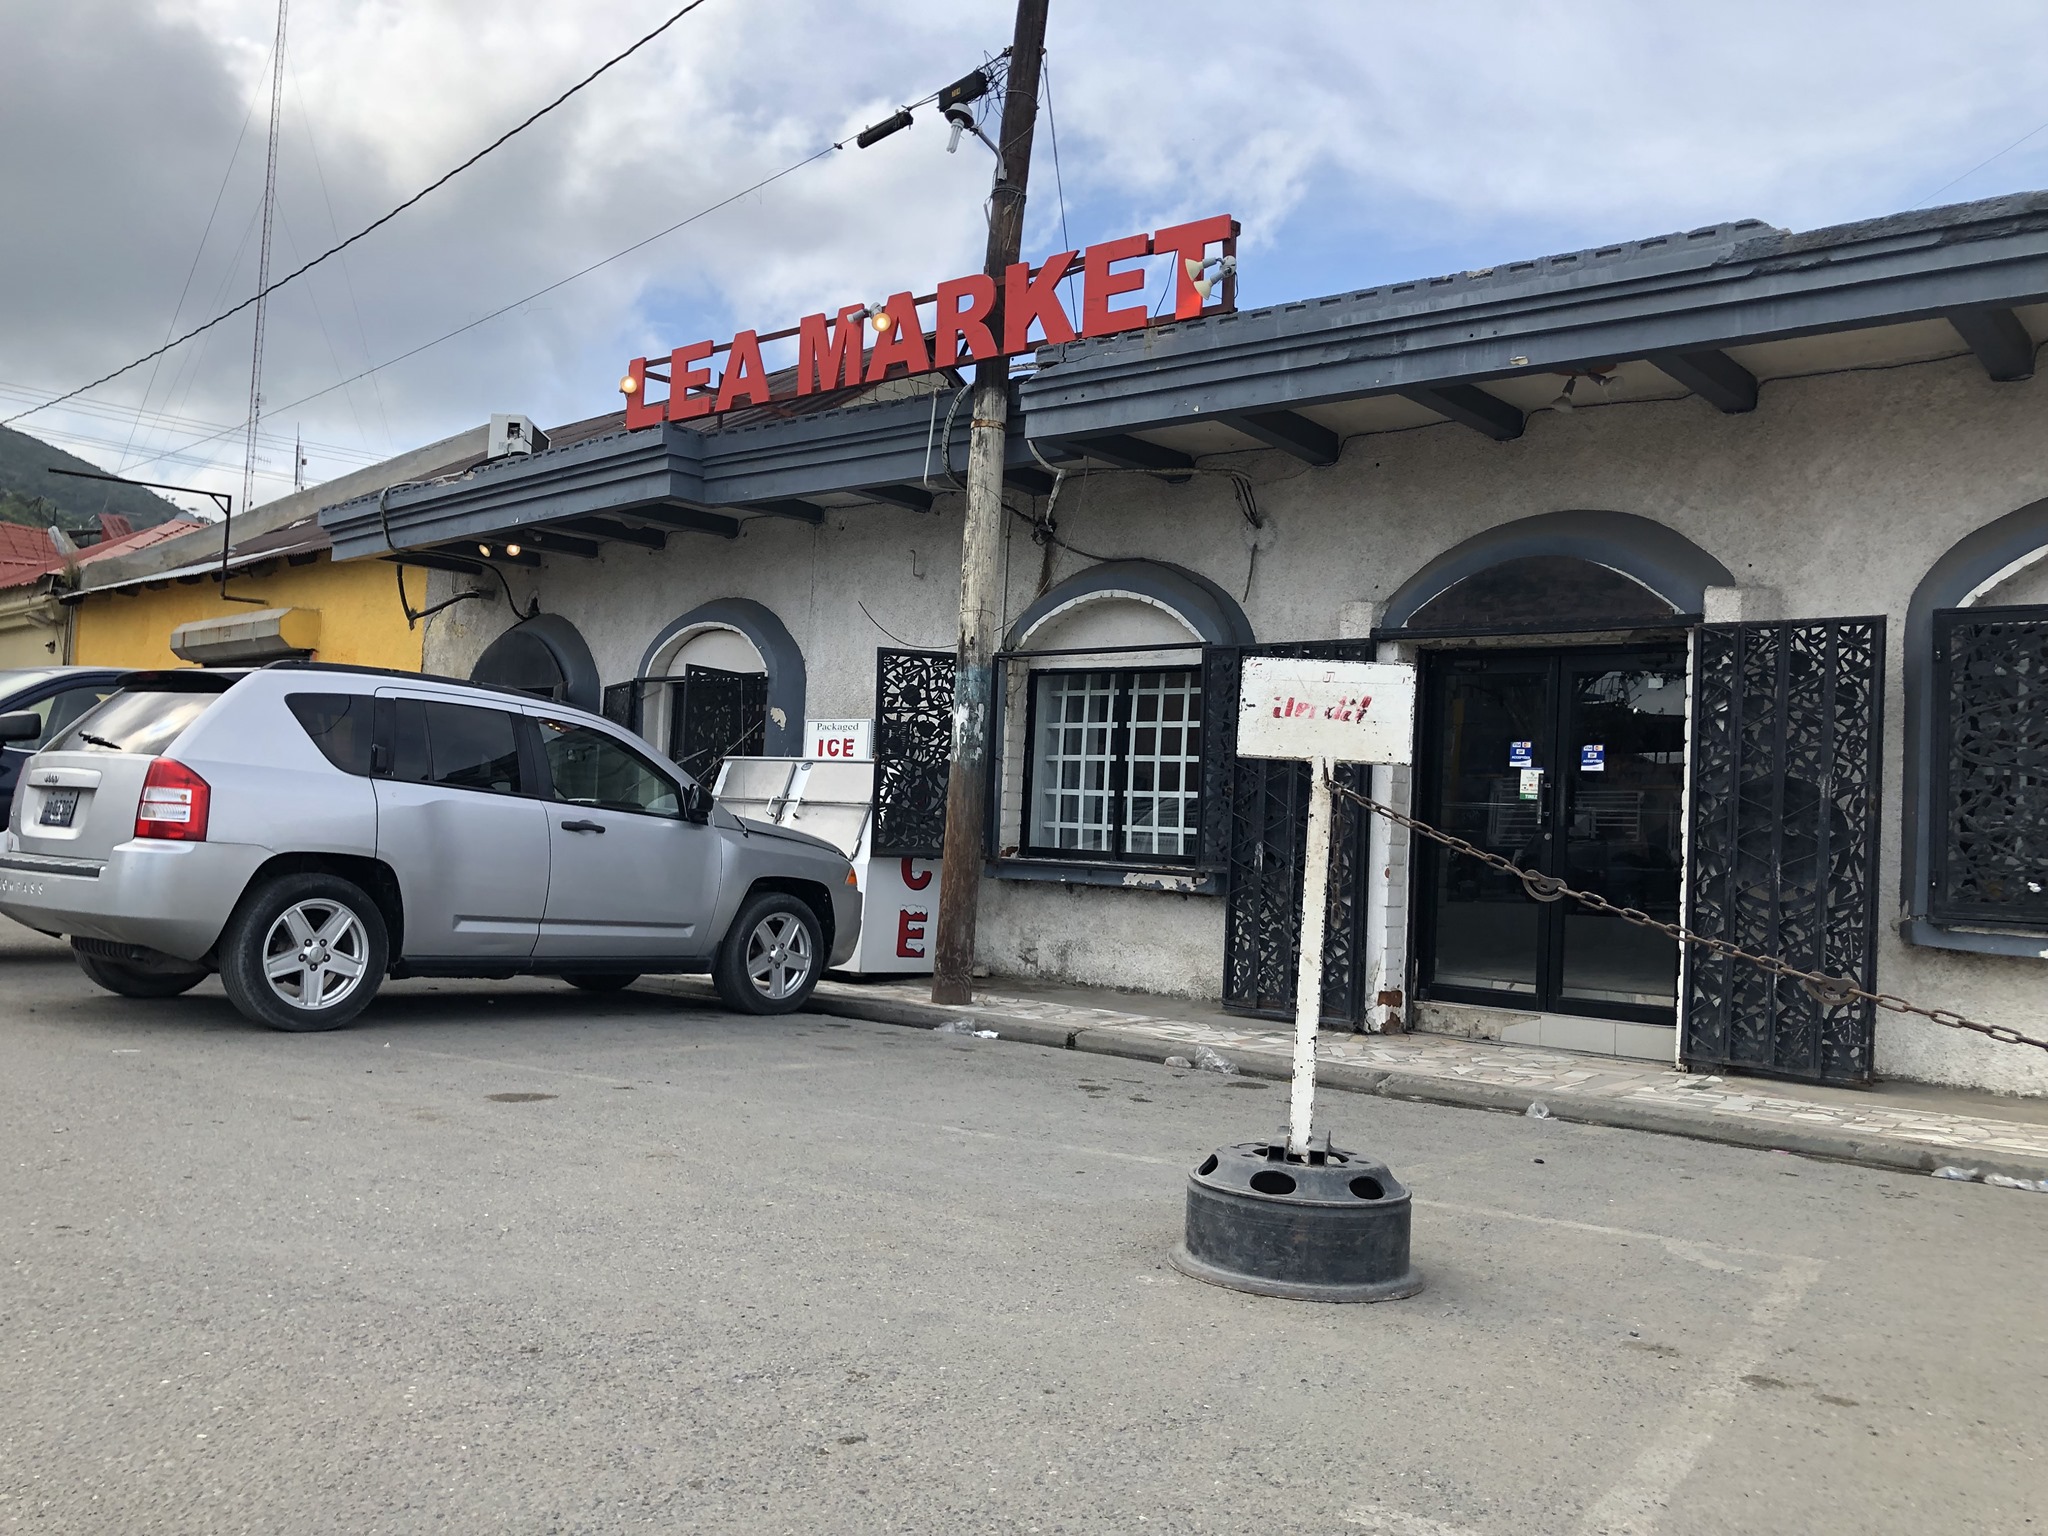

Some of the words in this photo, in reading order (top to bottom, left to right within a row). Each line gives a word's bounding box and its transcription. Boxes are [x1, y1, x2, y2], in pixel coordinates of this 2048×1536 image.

[626, 329, 770, 430] LEA
[799, 214, 1232, 396] MARKET
[817, 722, 859, 732] Packaged
[817, 737, 855, 757] ICE
[896, 858, 933, 958] CE
